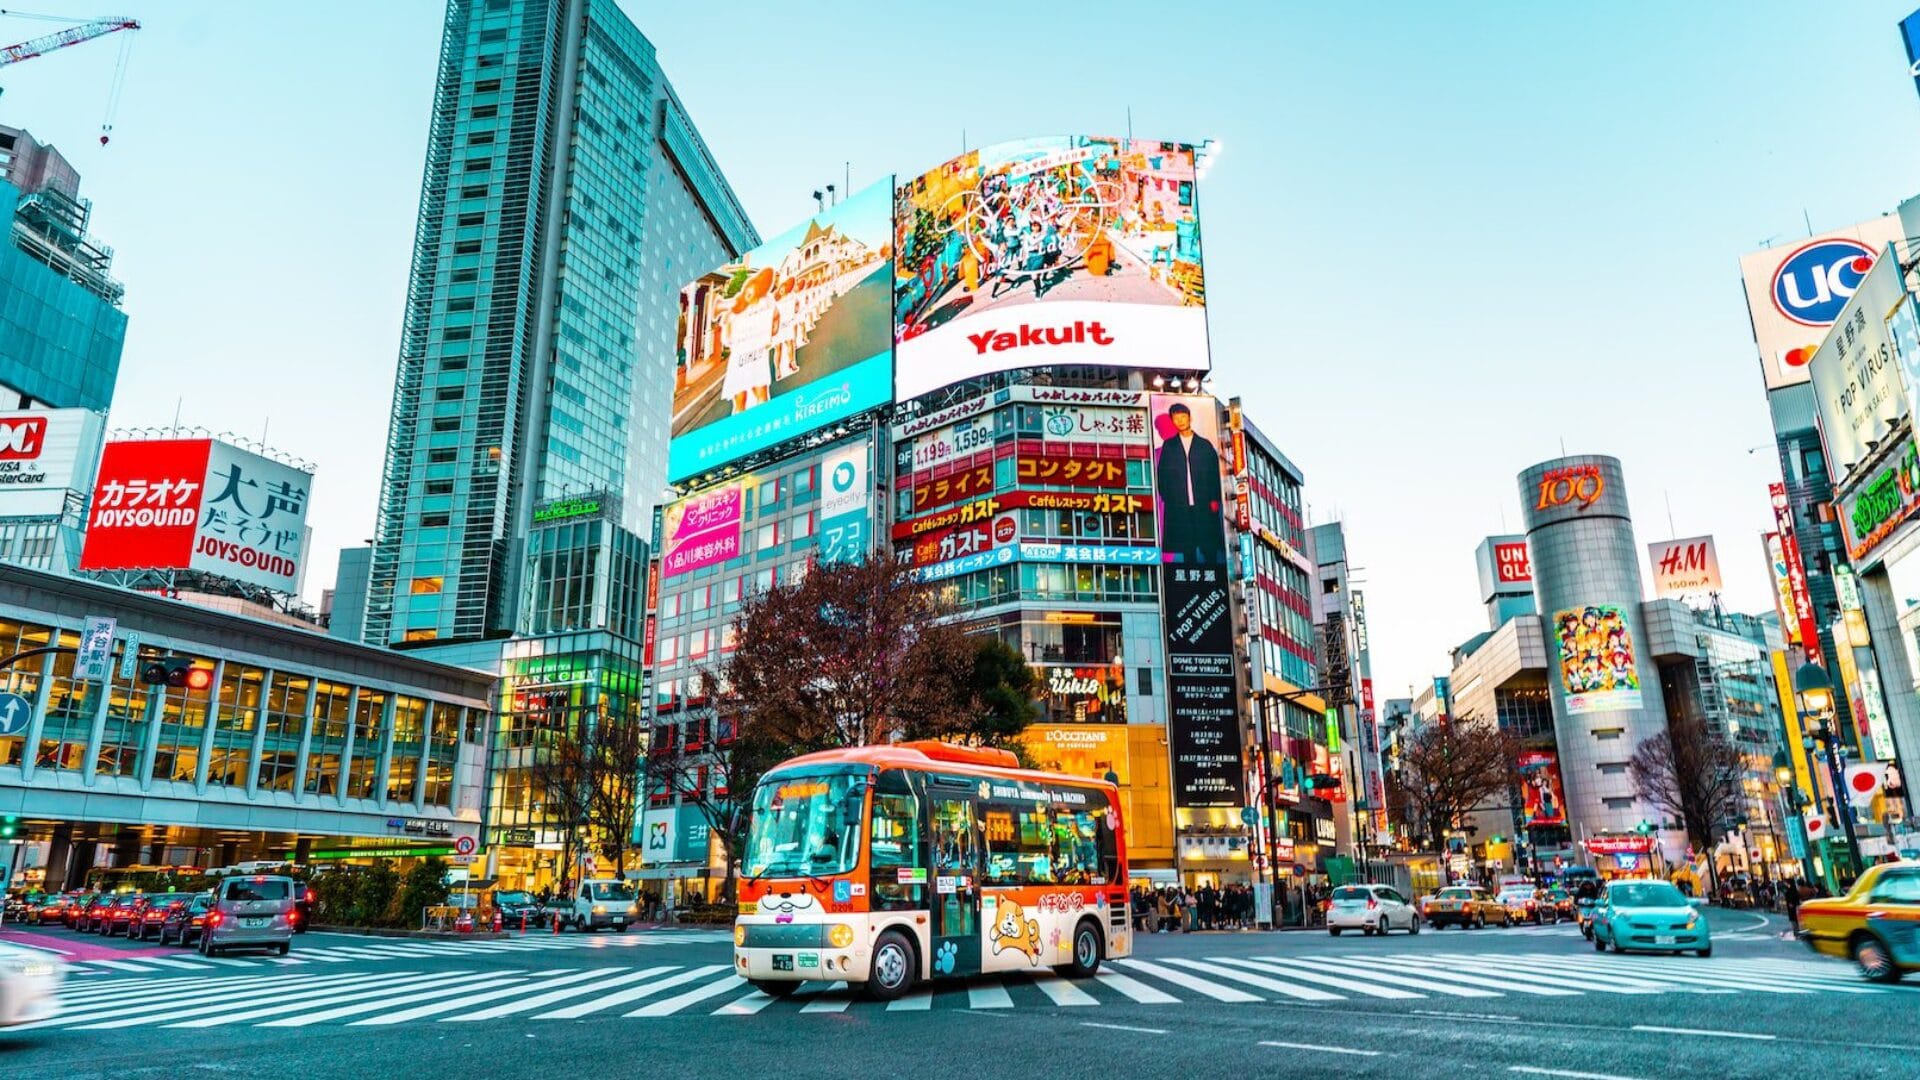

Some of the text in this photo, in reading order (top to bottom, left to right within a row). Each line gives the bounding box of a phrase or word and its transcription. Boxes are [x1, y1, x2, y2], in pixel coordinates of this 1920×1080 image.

[967, 321, 1115, 355] Yakult
[1857, 343, 1889, 391] VIRUS
[795, 390, 851, 422] KIREIMO
[1032, 387, 1142, 404] しゃぶしゃぶバイキング
[1080, 413, 1145, 434] しゃぶ葉
[897, 450, 912, 465] 9F
[1018, 459, 1123, 481] コンタクト
[99, 478, 199, 507] カラオケ
[207, 463, 307, 518] 大声
[915, 467, 993, 506] プライス
[1536, 474, 1605, 511] 109
[698, 506, 732, 528] クリニック
[960, 498, 1000, 524] ガスト
[1093, 493, 1142, 513] ガスト
[94, 508, 196, 529] JOYSOUND
[196, 535, 296, 578] JOYSOUND
[940, 529, 988, 561] ガスト
[1065, 547, 1157, 560] 英会話イーオン
[1658, 542, 1707, 576] H&M
